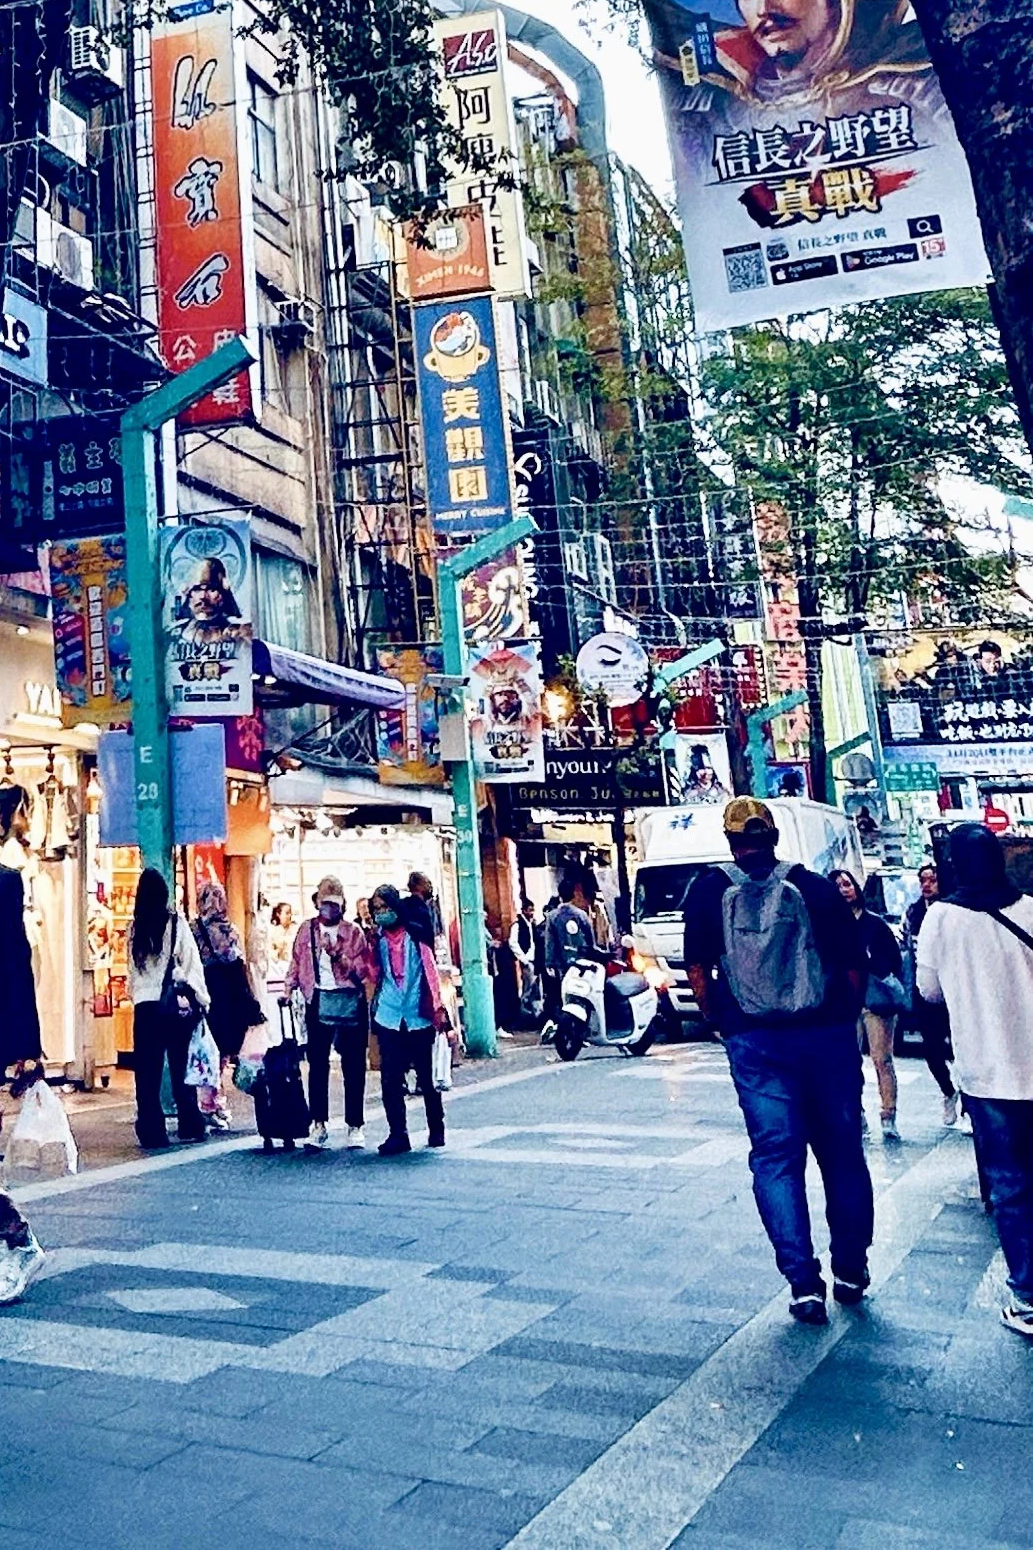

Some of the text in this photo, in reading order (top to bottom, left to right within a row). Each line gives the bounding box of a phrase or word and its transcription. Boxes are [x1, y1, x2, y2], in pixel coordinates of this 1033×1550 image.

[714, 105, 917, 179] 信長之野望
[769, 168, 880, 226] 真戰
[797, 230, 860, 251] 信長之野望
[441, 386, 489, 504] 美觀園
[140, 746, 153, 763] E
